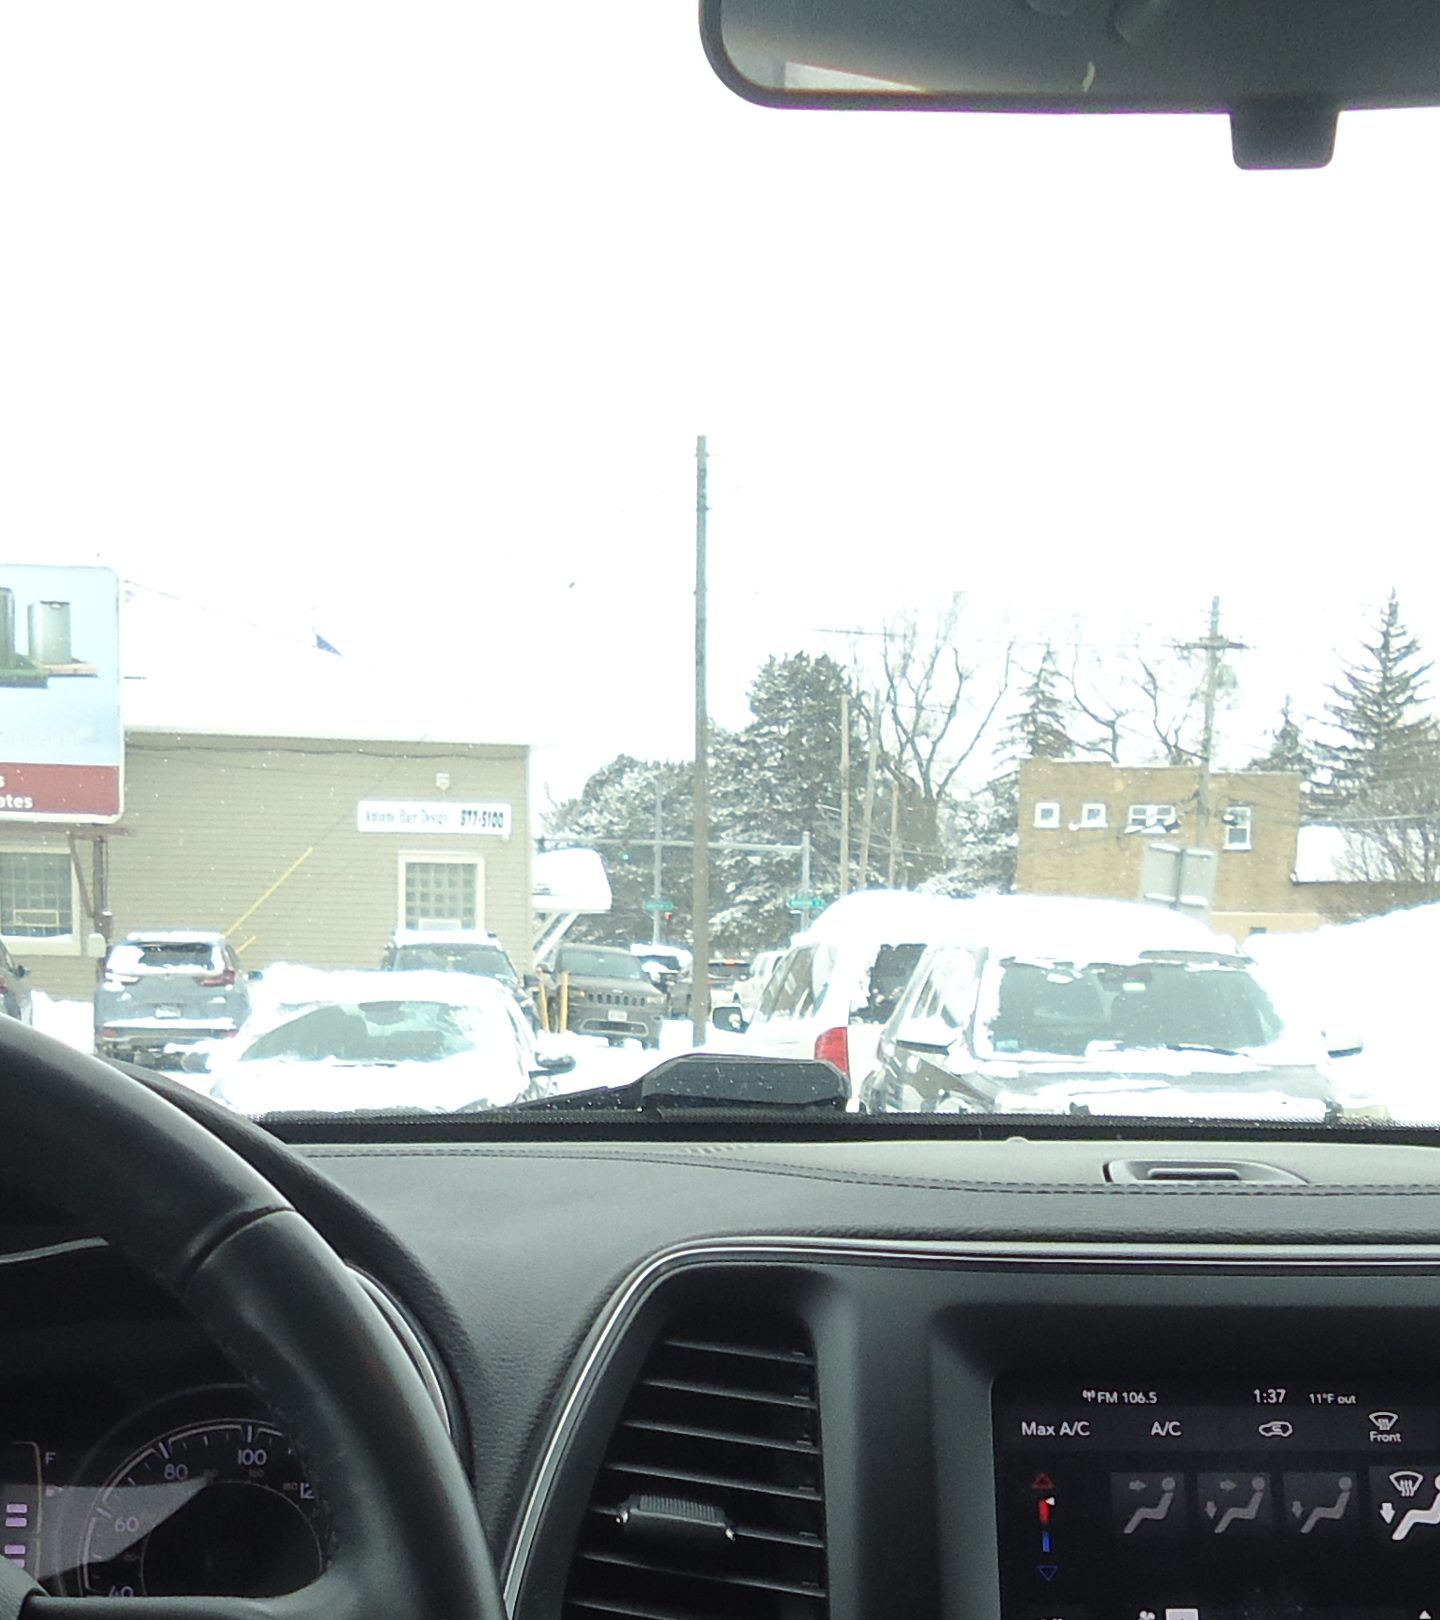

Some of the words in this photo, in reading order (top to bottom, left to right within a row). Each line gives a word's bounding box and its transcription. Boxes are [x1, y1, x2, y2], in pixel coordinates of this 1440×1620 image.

[1097, 1391, 1118, 1404] FM
[1122, 1391, 1158, 1405] 106.5
[1252, 1389, 1287, 1405] 1:37
[1308, 1393, 1335, 1405] 11°F
[1336, 1394, 1357, 1405] out
[1021, 1421, 1057, 1437] Max
[1060, 1421, 1091, 1438] A/C
[1150, 1421, 1182, 1438] A/C
[1369, 1430, 1402, 1443] Front
[44, 1451, 56, 1465] F
[237, 1448, 268, 1466] 100
[163, 1463, 189, 1481] 80
[299, 1482, 316, 1500] 12
[114, 1516, 139, 1533] 60
